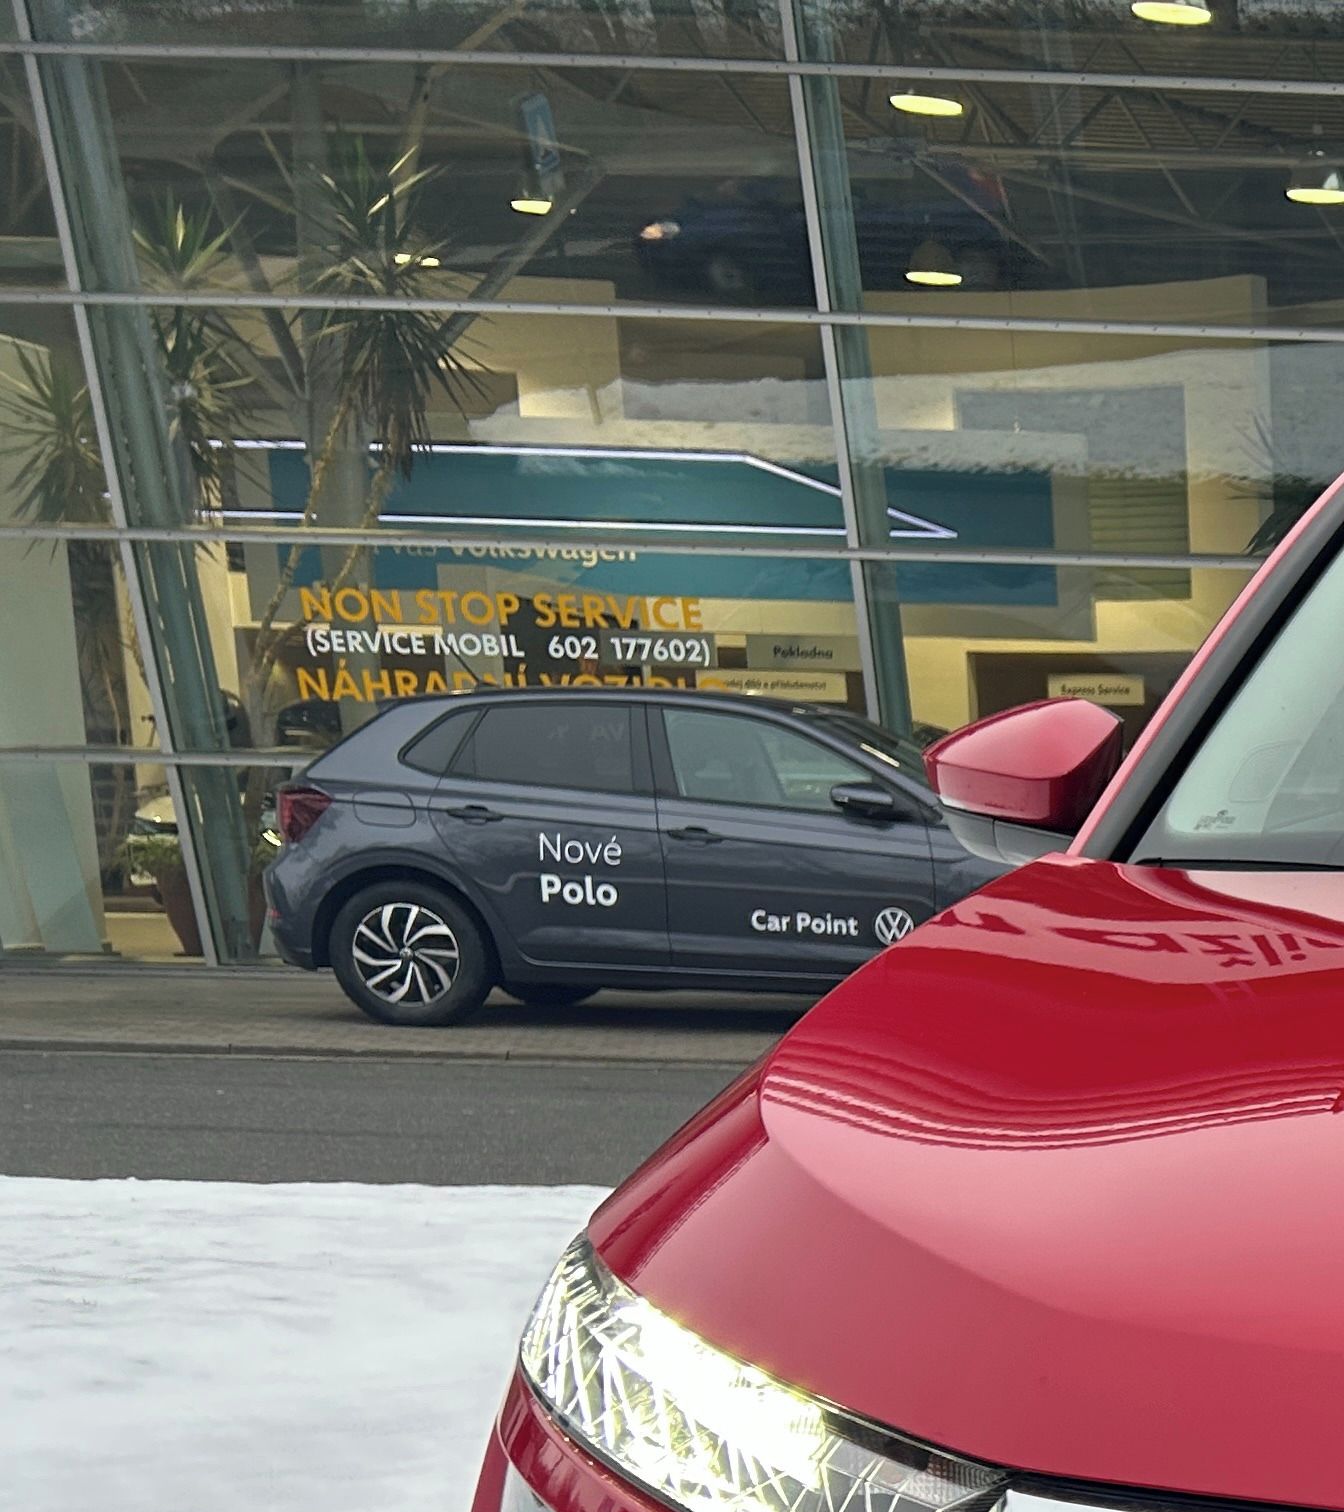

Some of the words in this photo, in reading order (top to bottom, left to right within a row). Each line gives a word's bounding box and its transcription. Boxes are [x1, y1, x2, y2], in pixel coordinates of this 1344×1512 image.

[301, 587, 404, 623] NON
[417, 590, 520, 626] STOP
[534, 594, 704, 631] SERVICE
[306, 629, 425, 657] (SERVICE
[434, 632, 525, 659] MOBIL
[548, 635, 599, 661] 602
[611, 637, 711, 668] 177602)
[539, 832, 622, 866] Nové
[540, 873, 618, 907] Polo
[751, 908, 791, 932] Car
[796, 911, 860, 937] Point
